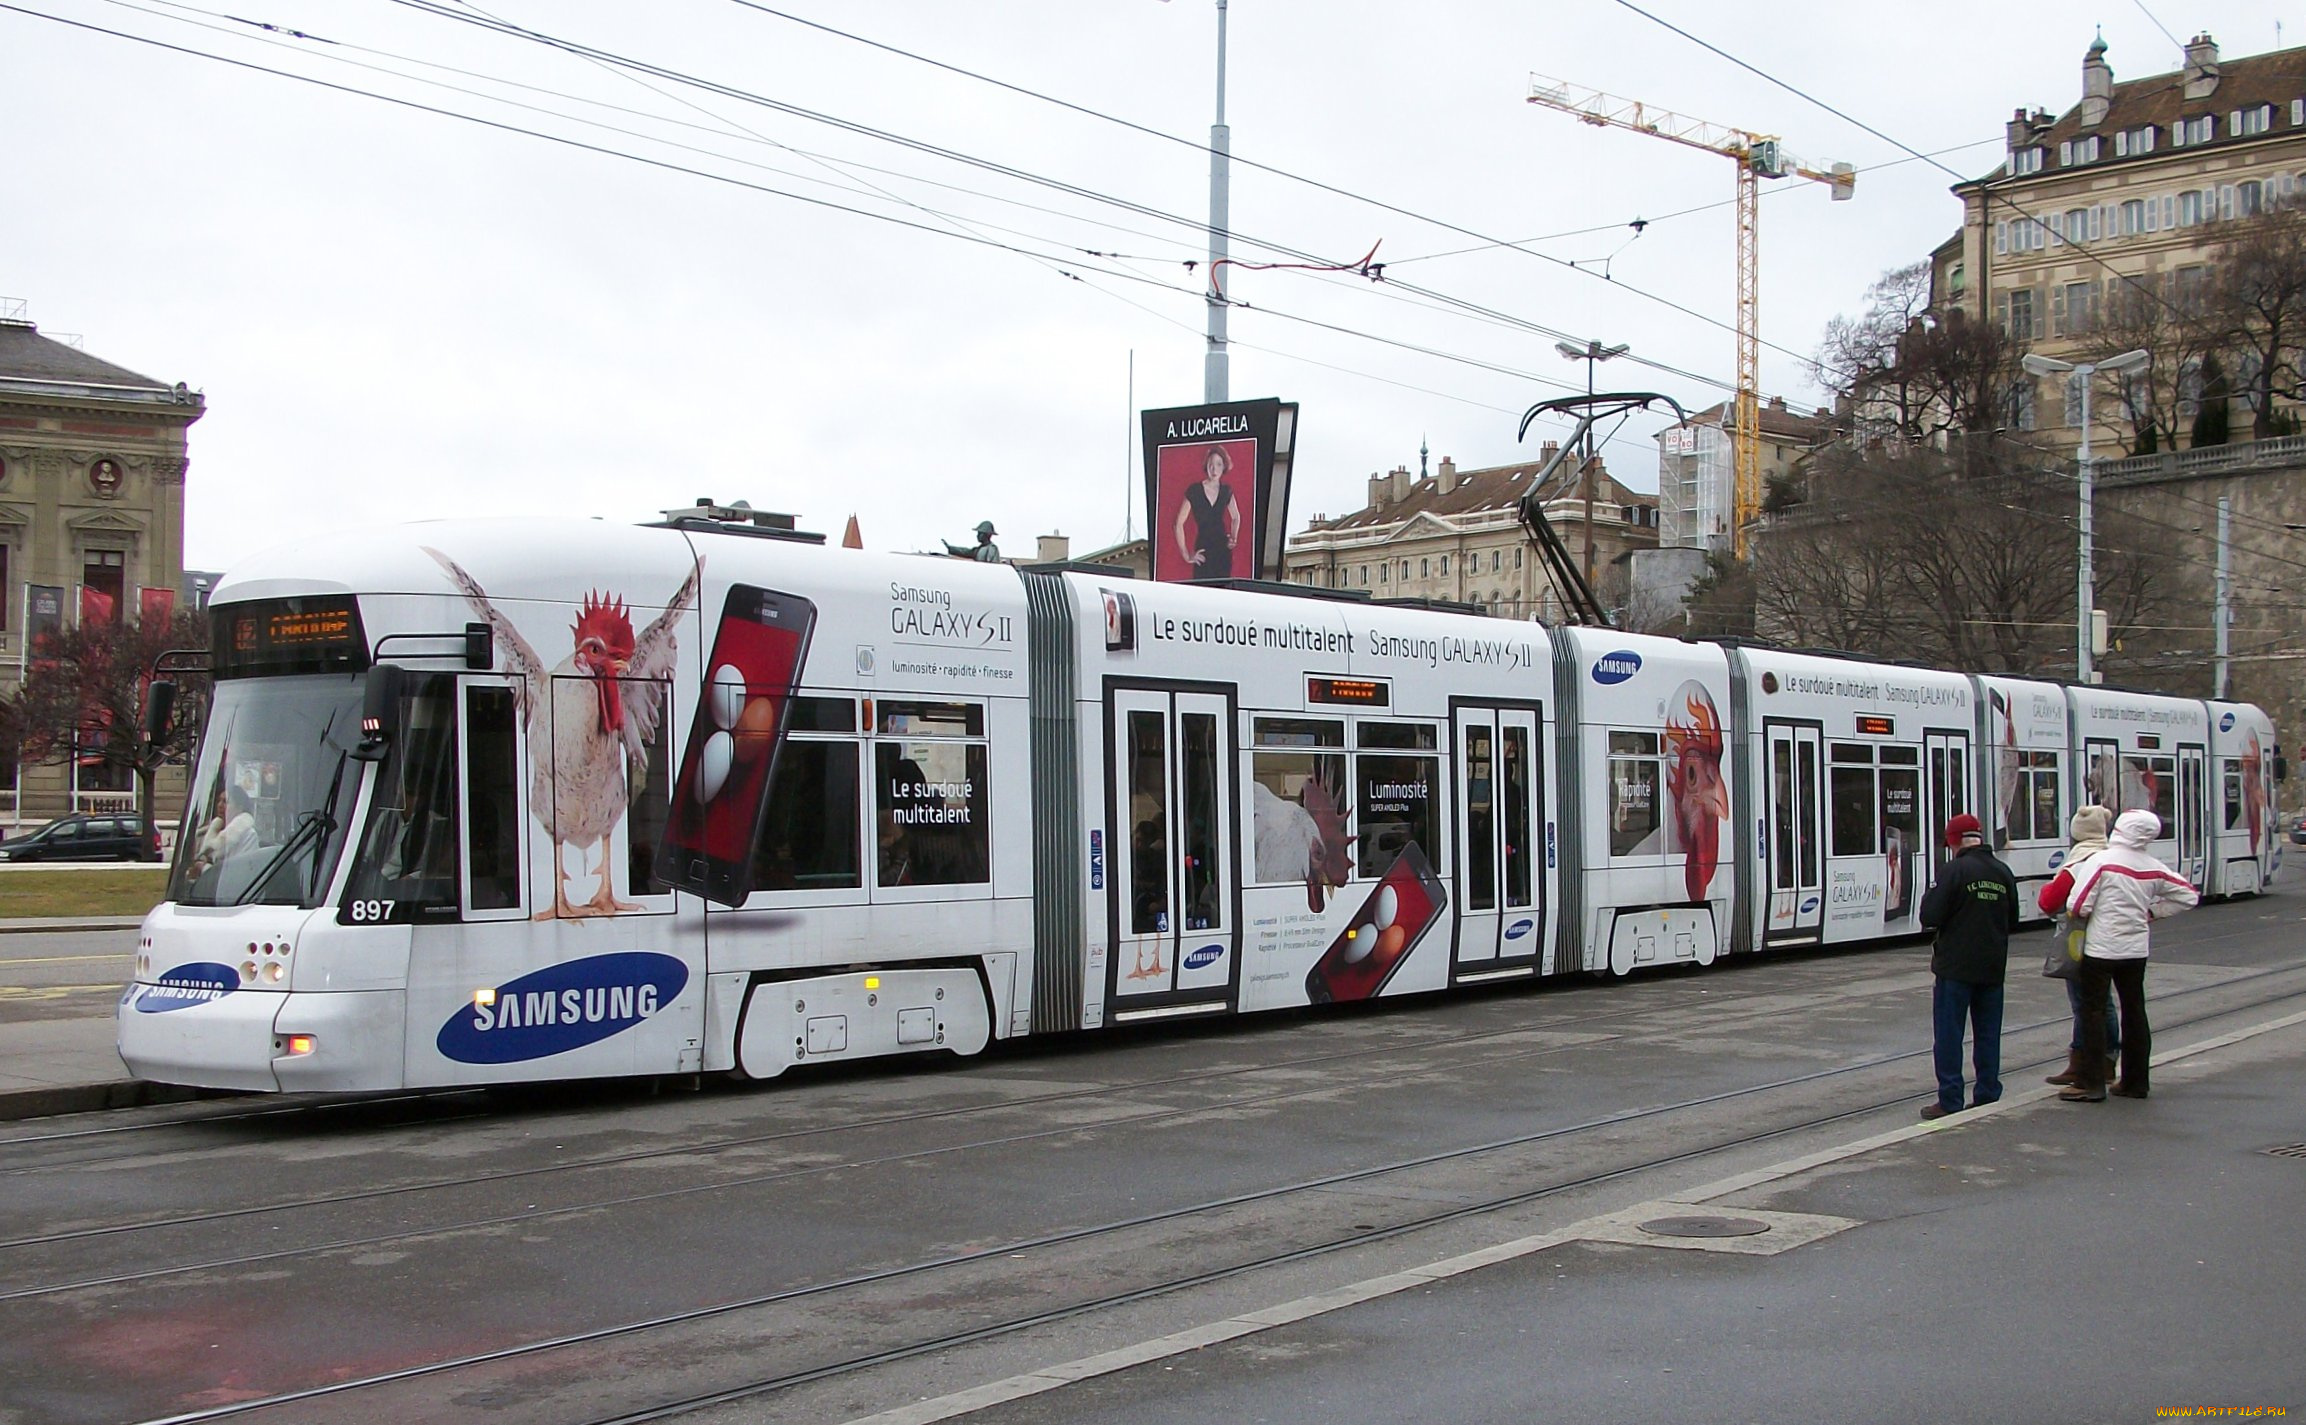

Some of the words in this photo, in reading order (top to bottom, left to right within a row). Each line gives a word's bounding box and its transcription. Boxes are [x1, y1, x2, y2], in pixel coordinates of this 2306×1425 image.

[1167, 421, 1178, 438] A.
[1181, 415, 1248, 437] LUCARELLA
[891, 582, 951, 611] Samsung
[892, 607, 973, 639] GALAXY
[1153, 611, 1175, 640] Le
[1182, 616, 1257, 646] surdoué
[1264, 621, 1355, 654] multitalent
[1370, 629, 1437, 668] Samsung
[1442, 636, 1502, 665] GALAXY
[892, 660, 938, 675] luminosité
[943, 665, 977, 679] rapidité
[983, 666, 1014, 679] finesse
[1598, 658, 1637, 676] SAMSUNG
[1785, 673, 1797, 693] Le
[1799, 675, 1834, 696] surdoué
[1836, 679, 1880, 701] multitalent
[1885, 682, 1919, 709] Samsung
[1921, 686, 1950, 707] GALAXY
[892, 778, 910, 798] Le
[914, 778, 973, 798] surdoué
[1370, 779, 1428, 799] Luminosité
[1619, 780, 1651, 802] Rapidité
[893, 803, 971, 824] multitalent
[351, 899, 396, 921] 897
[1189, 951, 1220, 963] SAMSUNG
[149, 979, 225, 1001] SAMSUNG
[473, 984, 658, 1032] SAMSUNG
